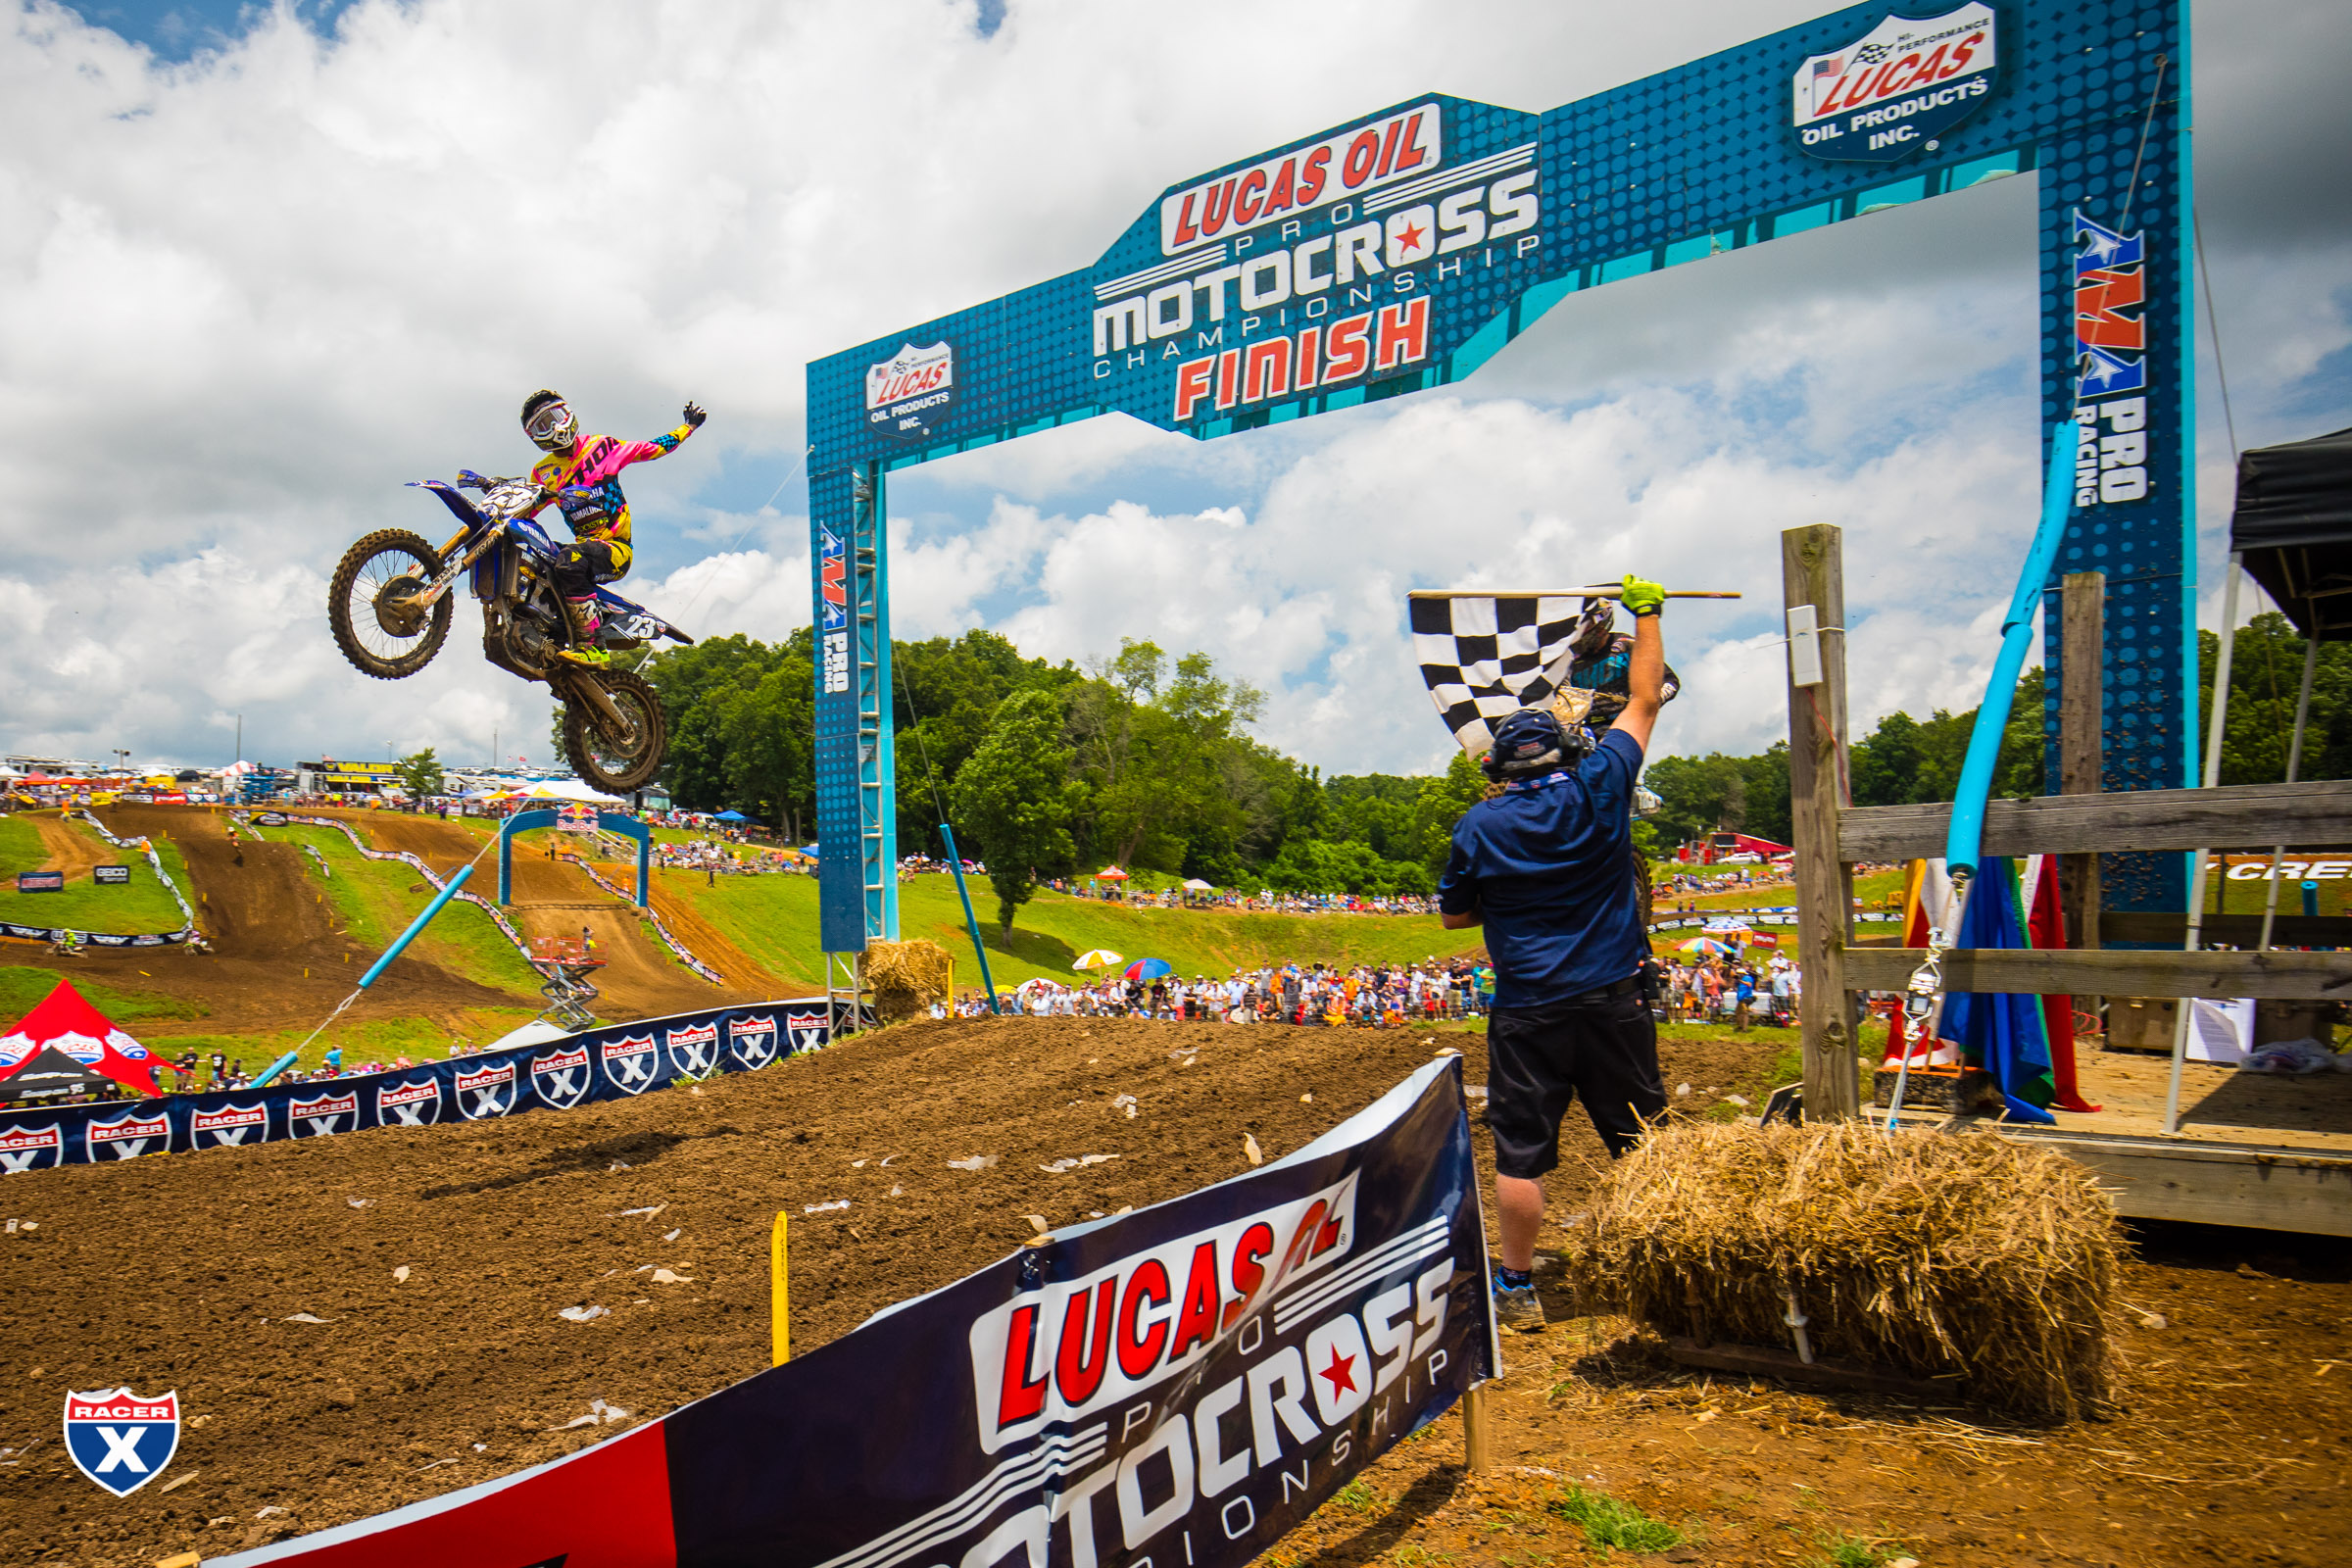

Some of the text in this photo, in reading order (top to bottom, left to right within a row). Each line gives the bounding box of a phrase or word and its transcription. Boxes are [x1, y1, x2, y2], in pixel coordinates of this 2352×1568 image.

[1897, 18, 1989, 53] PERFORMANCE
[1814, 32, 1986, 117] LUCAS
[1801, 78, 1988, 145] OIL PRODUCTS
[1869, 124, 1921, 150] INC.
[1173, 111, 1427, 248] LUCAS OIL
[1235, 203, 1353, 257] PRO
[1093, 169, 1540, 357] MOTOCROSS
[1095, 234, 1541, 379] CHAMPIONSHIP
[2073, 207, 2146, 399] AMA
[1174, 294, 1432, 421] FINISH
[876, 362, 948, 404] LUCAS
[870, 391, 950, 422] OIL PRODUCTS
[899, 416, 922, 430] INC.
[2075, 405, 2099, 508] RACING
[2099, 396, 2147, 504] PRO
[626, 614, 657, 639] 23
[831, 632, 850, 693] PRO
[2227, 860, 2352, 880] CRE
[732, 1023, 772, 1034] RACER
[791, 1018, 828, 1027] RACER
[606, 1042, 652, 1055] RACER
[671, 1030, 714, 1045] RACER
[742, 1034, 768, 1060] X
[800, 1029, 822, 1054] X
[535, 1054, 584, 1071] RACER
[617, 1054, 649, 1084] X
[682, 1043, 710, 1071] X
[461, 1071, 513, 1089] RACER
[548, 1067, 579, 1100] X
[295, 1101, 352, 1116] RACER
[383, 1087, 435, 1103] RACER
[473, 1085, 506, 1117] X
[197, 1111, 264, 1127] RACER
[392, 1102, 424, 1127] X
[0, 1135, 54, 1149] ACER
[94, 1123, 165, 1139] RACER
[998, 1221, 1275, 1433] LUCAS
[1127, 1348, 1448, 1568] IONSHIP
